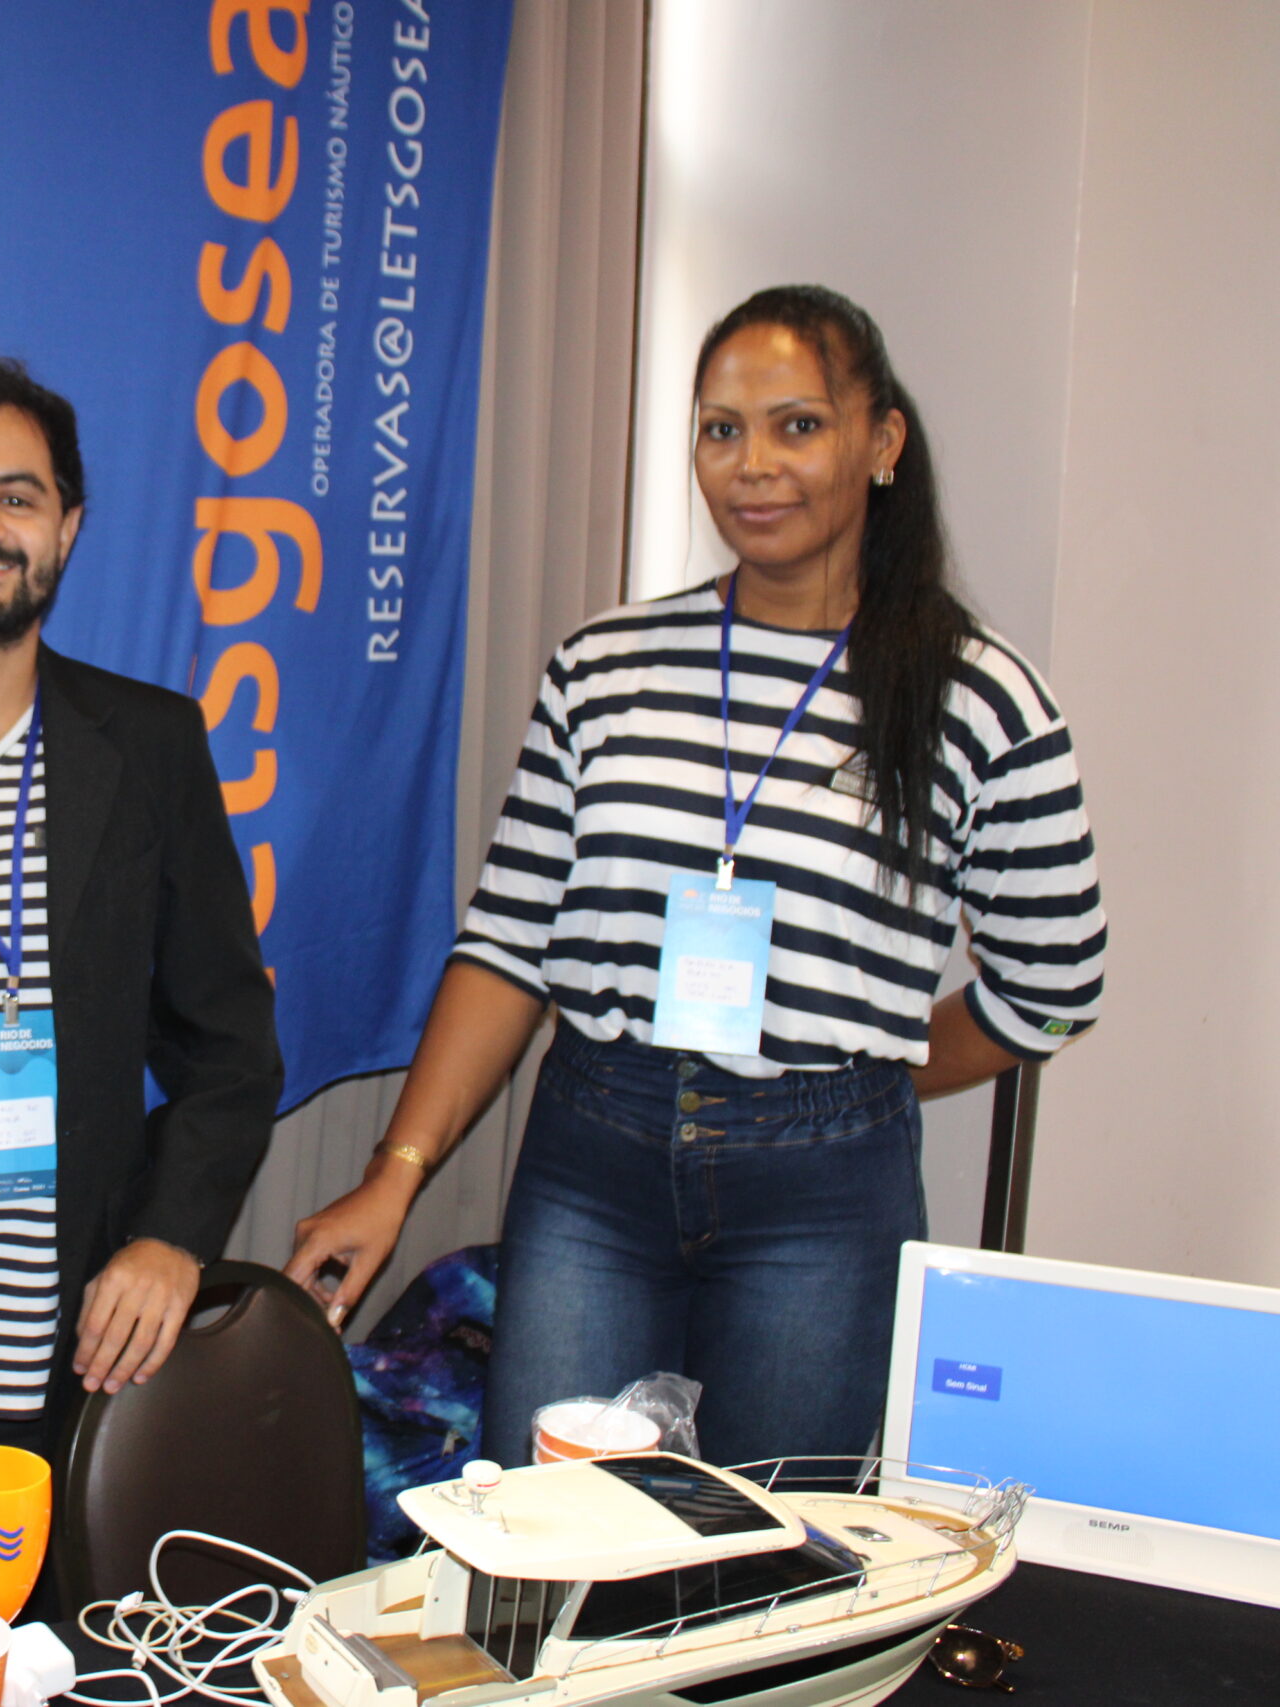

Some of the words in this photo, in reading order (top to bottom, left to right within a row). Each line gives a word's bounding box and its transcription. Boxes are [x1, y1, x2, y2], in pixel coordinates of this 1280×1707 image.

[324, 1, 354, 130] NÁUTICO
[323, 137, 347, 268] TURISMO
[322, 276, 340, 311] DE
[312, 321, 337, 496] OPERADORA
[192, 0, 323, 990] tsgosea
[0, 1029, 18, 1041] RIO
[20, 1028, 32, 1039] DE
[0, 1038, 53, 1052] NEGOCIOS
[1088, 1519, 1130, 1531] SEMP
